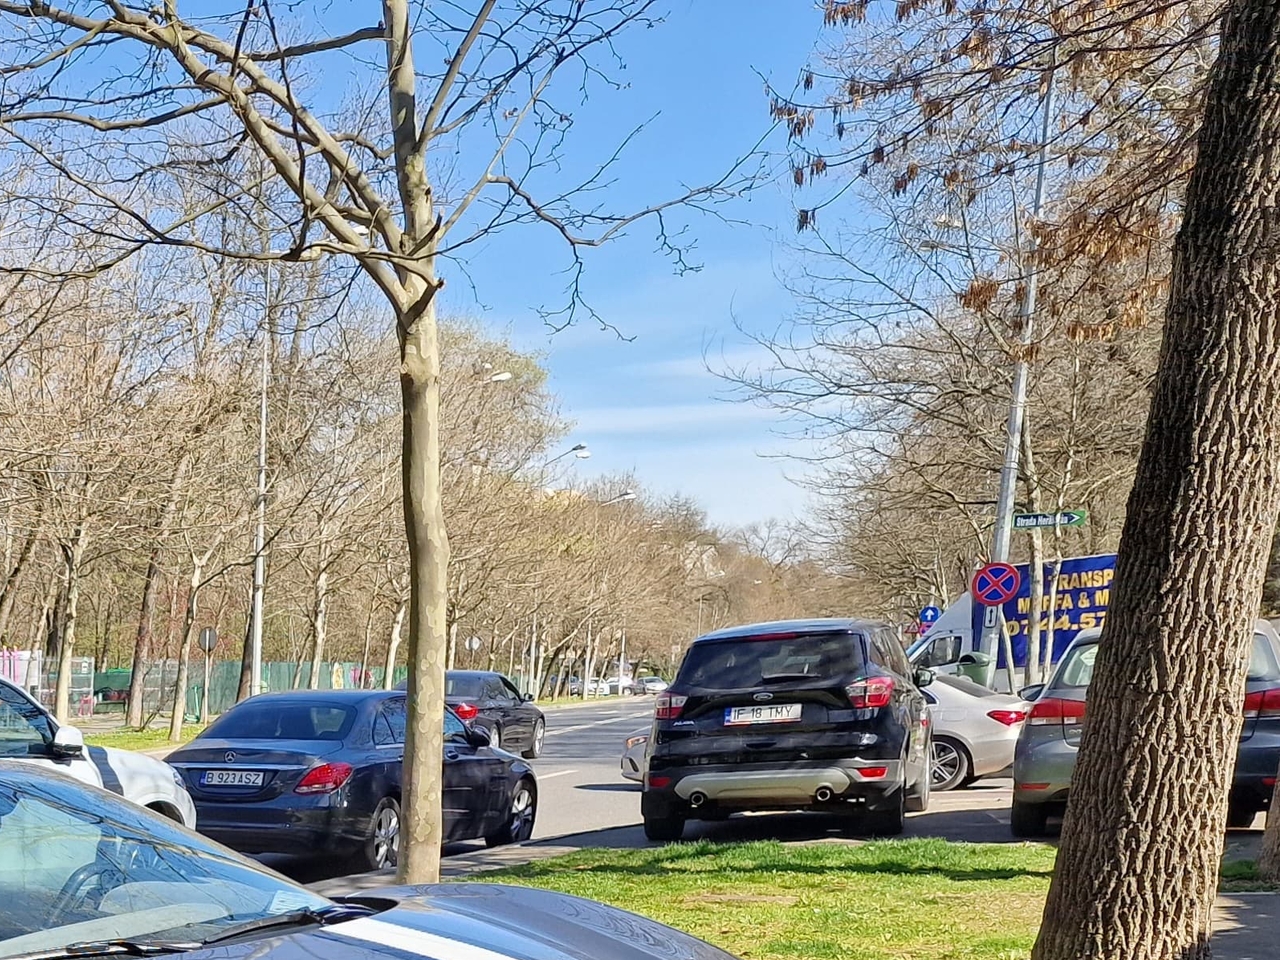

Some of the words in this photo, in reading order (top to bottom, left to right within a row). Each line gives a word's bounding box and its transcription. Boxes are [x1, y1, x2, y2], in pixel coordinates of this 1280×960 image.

[1016, 516, 1036, 527] Strada
[1048, 569, 1115, 591] RANSP
[1017, 593, 1074, 615] MRFA
[1078, 592, 1090, 608] &
[734, 709, 746, 720] IF
[751, 707, 763, 719] 18
[768, 706, 793, 718] TMY
[206, 772, 214, 783] B
